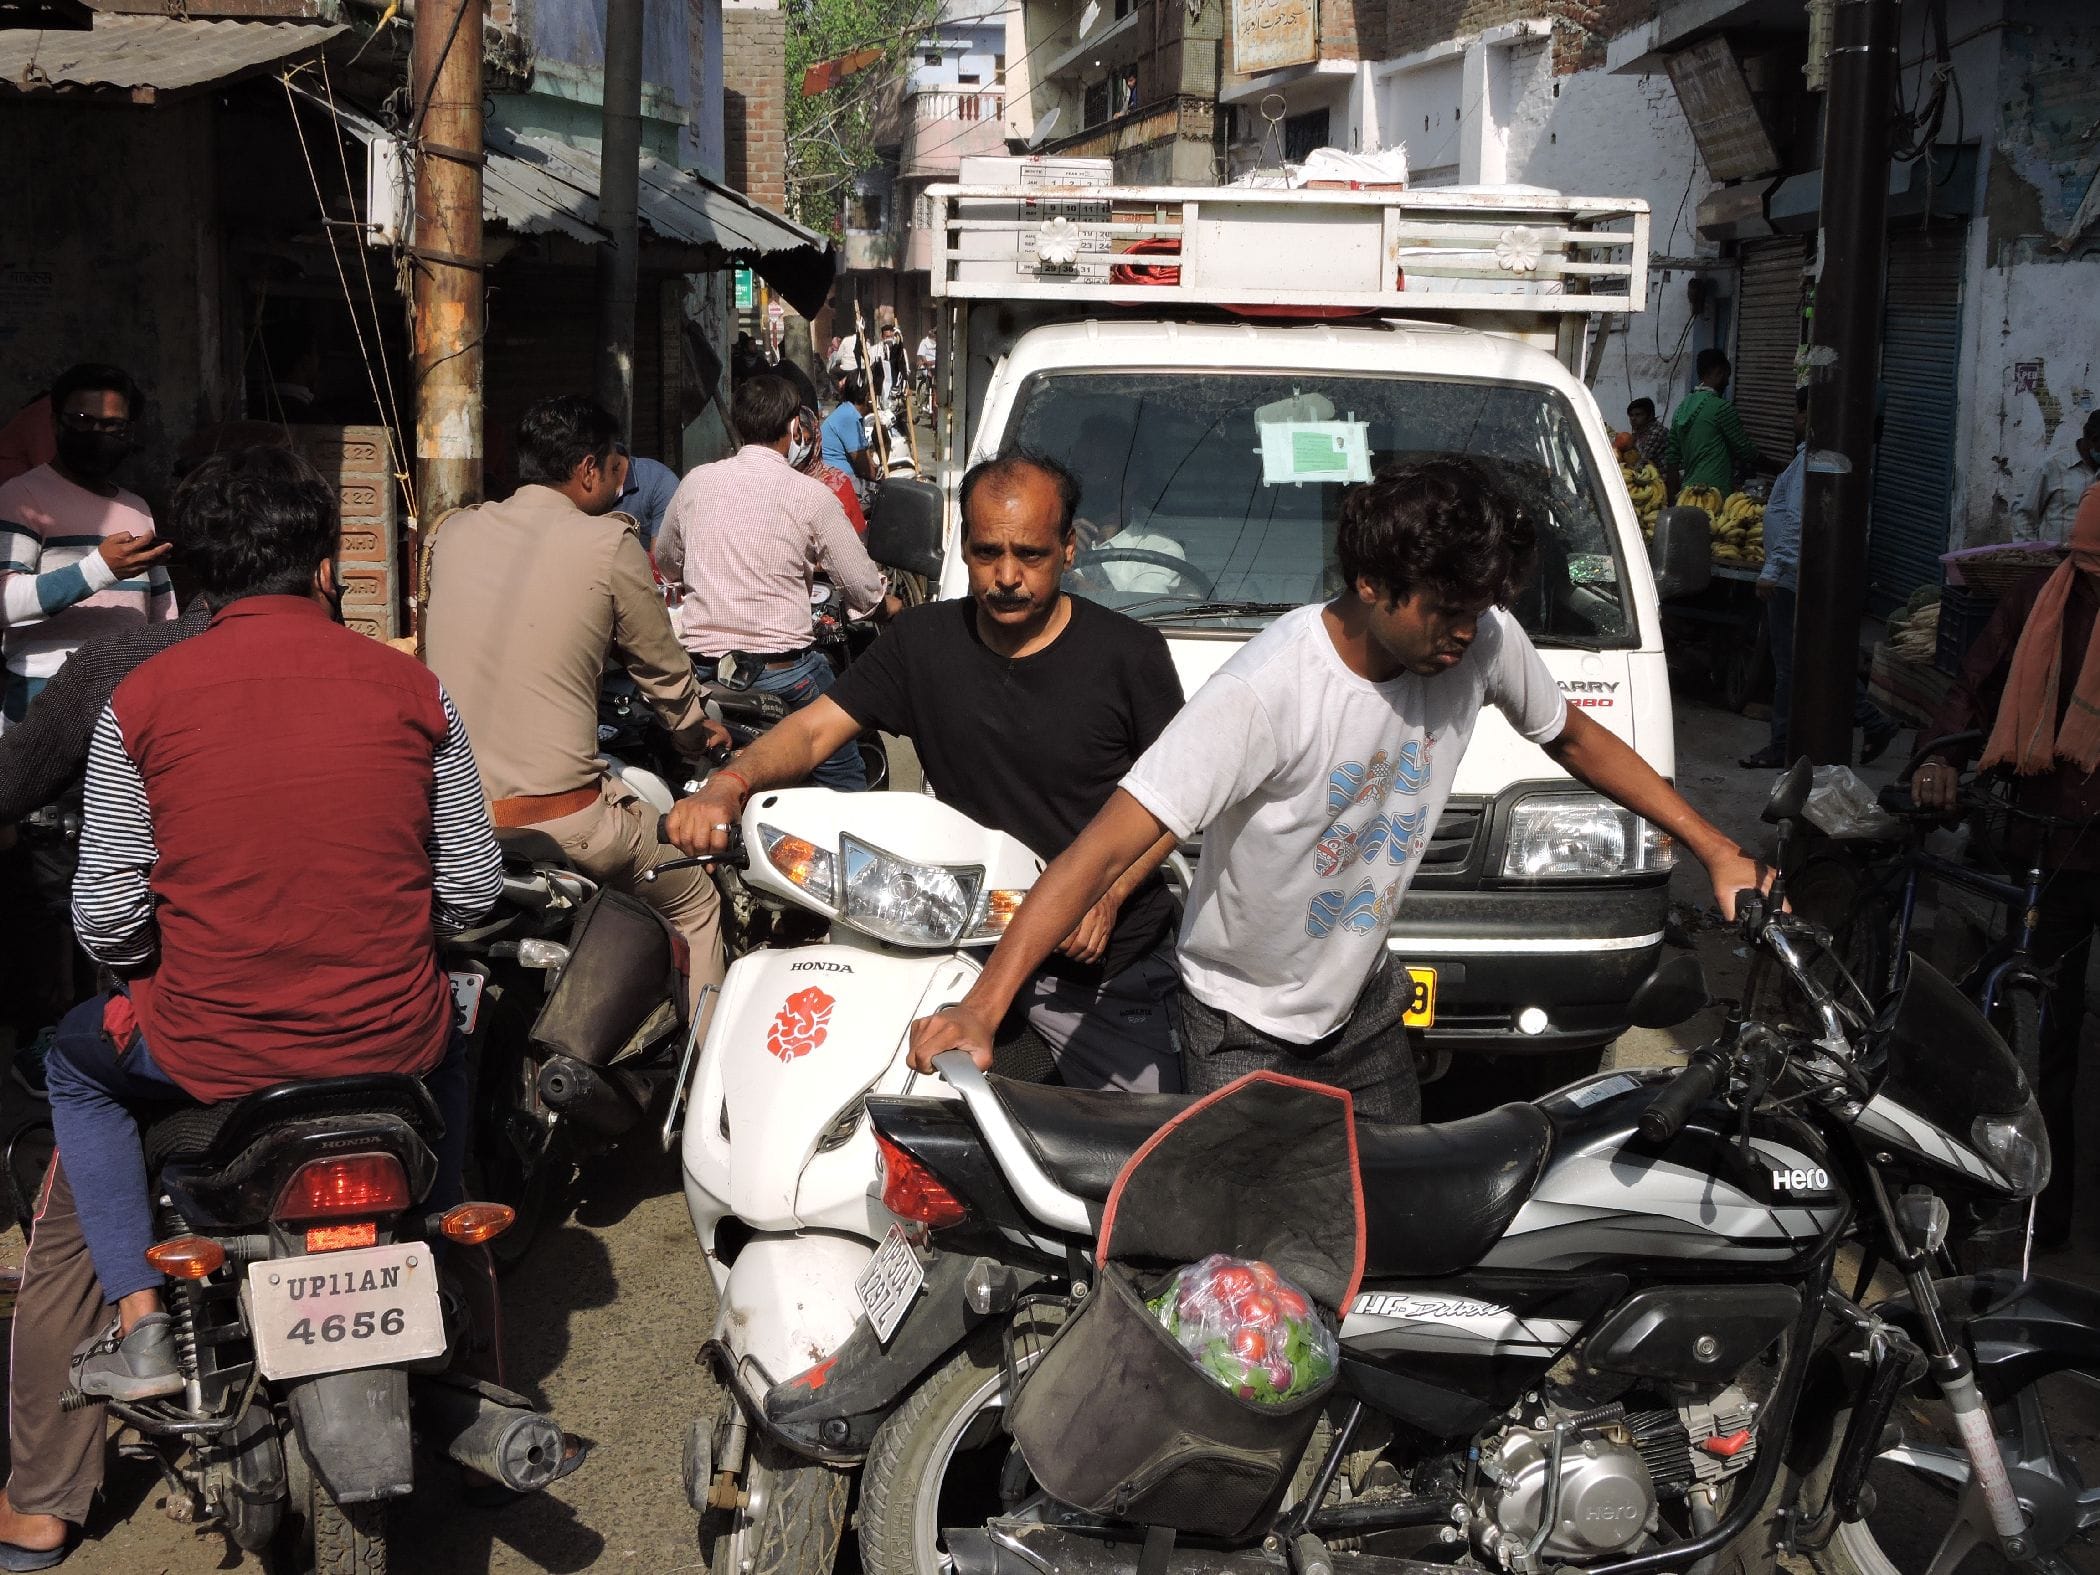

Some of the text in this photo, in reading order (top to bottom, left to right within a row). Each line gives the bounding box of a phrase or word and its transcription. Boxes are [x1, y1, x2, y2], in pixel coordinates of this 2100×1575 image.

[1066, 204, 1077, 212] 10
[1044, 264, 1056, 272] 29
[1062, 265, 1074, 273] 30
[1080, 266, 1091, 274] 31
[1556, 680, 1620, 694] ARRY
[790, 961, 856, 974] HONDA
[321, 1136, 382, 1149] HONDA
[1773, 1168, 1829, 1190] Hero
[287, 1266, 401, 1301] UP11AN
[1405, 1301, 1511, 1318] Deluxe
[287, 1308, 405, 1345] 4656
